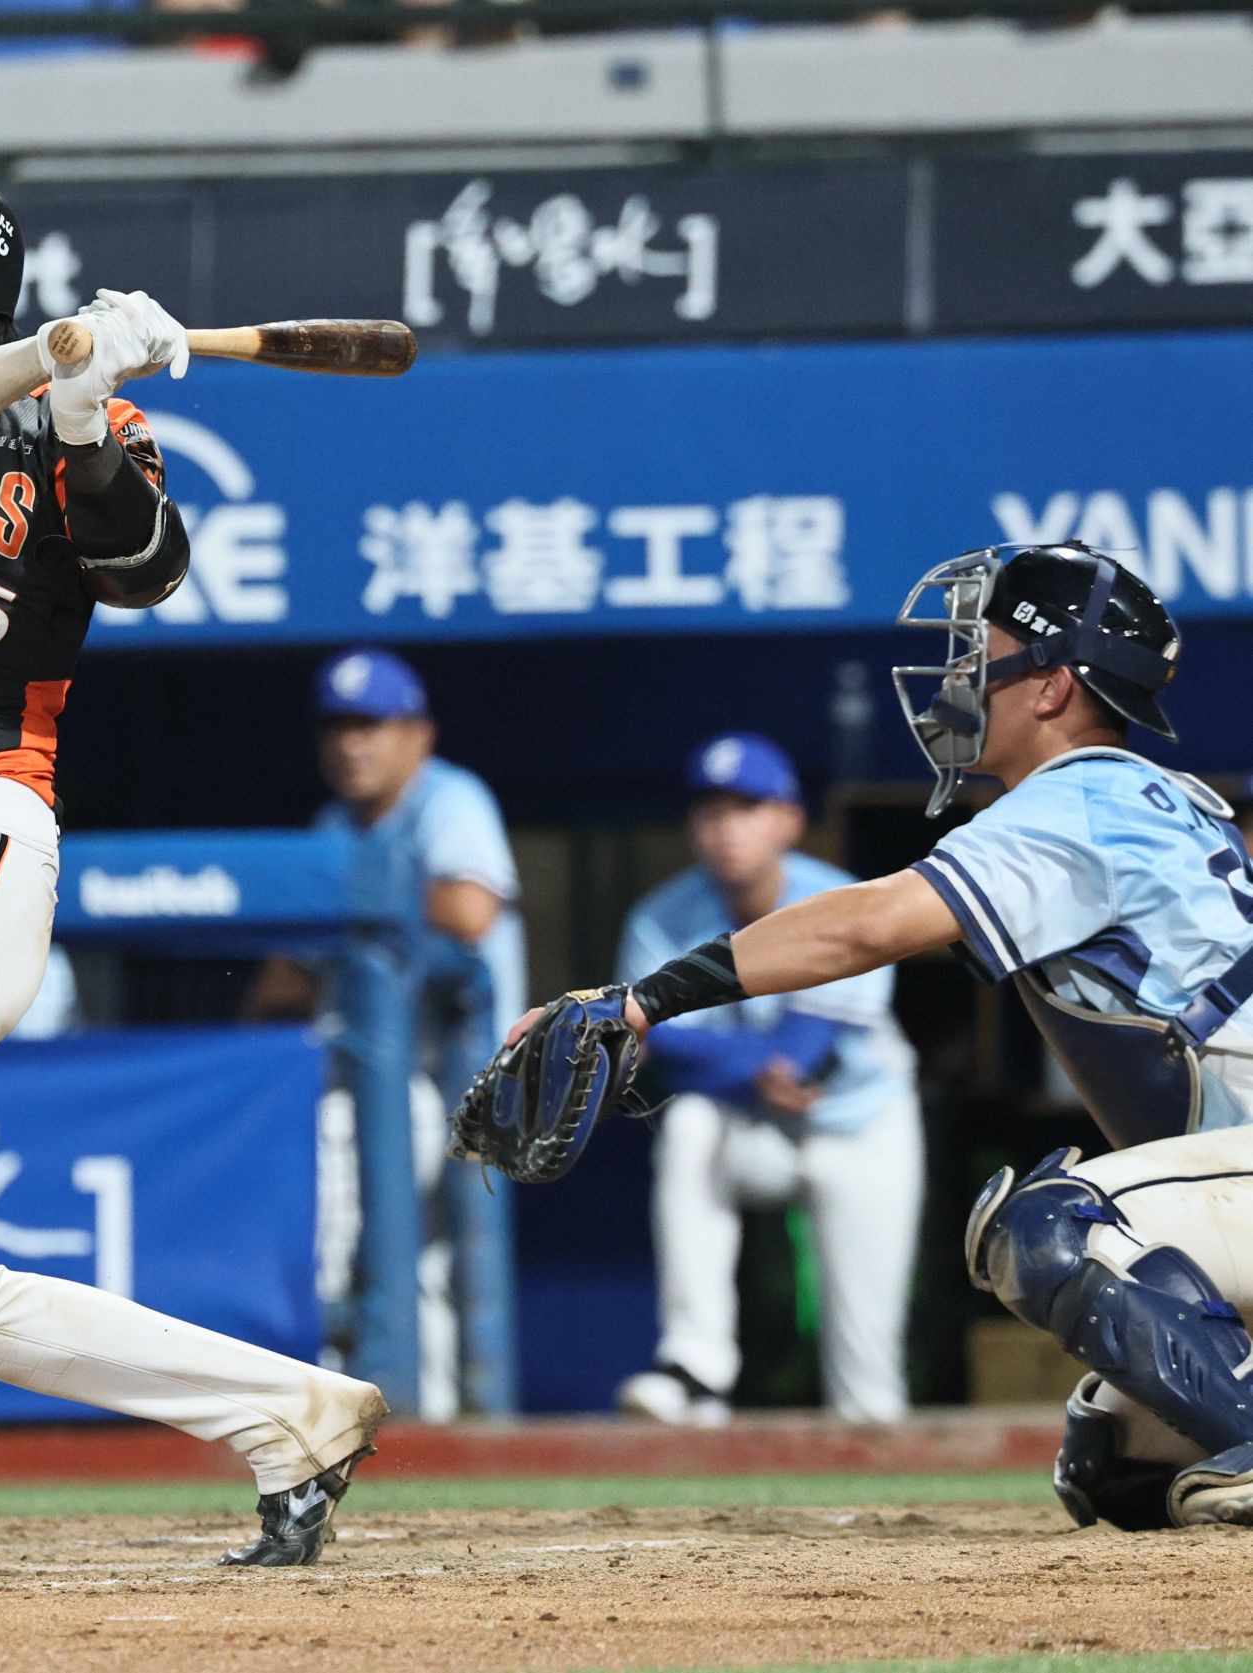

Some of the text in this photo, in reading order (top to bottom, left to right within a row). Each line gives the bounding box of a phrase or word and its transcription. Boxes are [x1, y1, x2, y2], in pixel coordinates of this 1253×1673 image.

[360, 497, 848, 619] 洋基工程
[993, 488, 1253, 600] YAN
